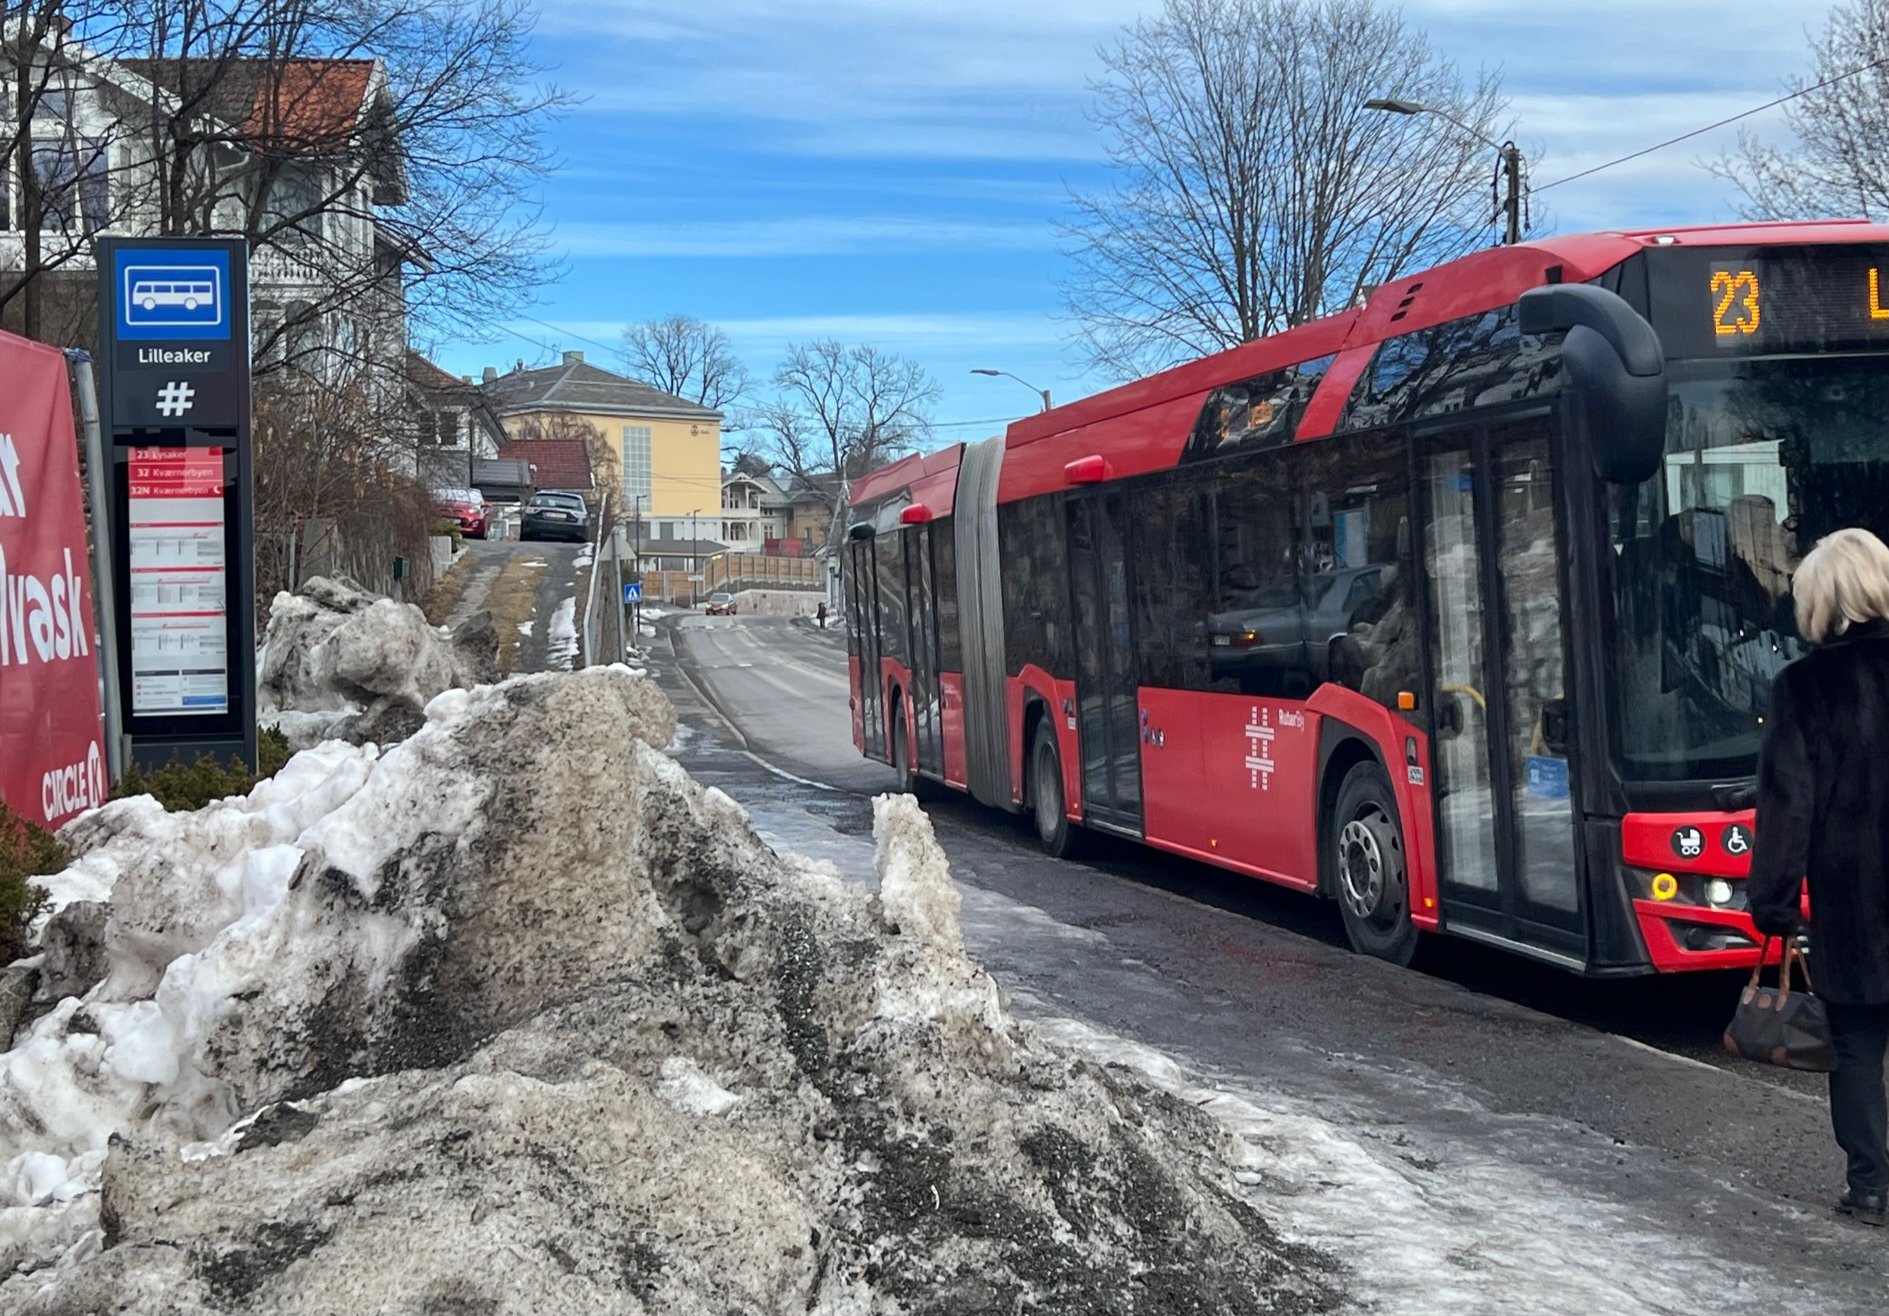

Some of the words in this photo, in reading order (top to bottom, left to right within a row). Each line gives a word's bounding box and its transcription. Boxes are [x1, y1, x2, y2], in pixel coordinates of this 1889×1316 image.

[1710, 271, 1761, 335] 23
[1868, 268, 1889, 319] L
[138, 348, 211, 363] Lilleaker
[137, 450, 149, 459] 23
[152, 449, 187, 461] Lysaker
[137, 468, 149, 477] 32
[130, 486, 150, 495] 32N
[42, 761, 88, 822] CIRCLE
